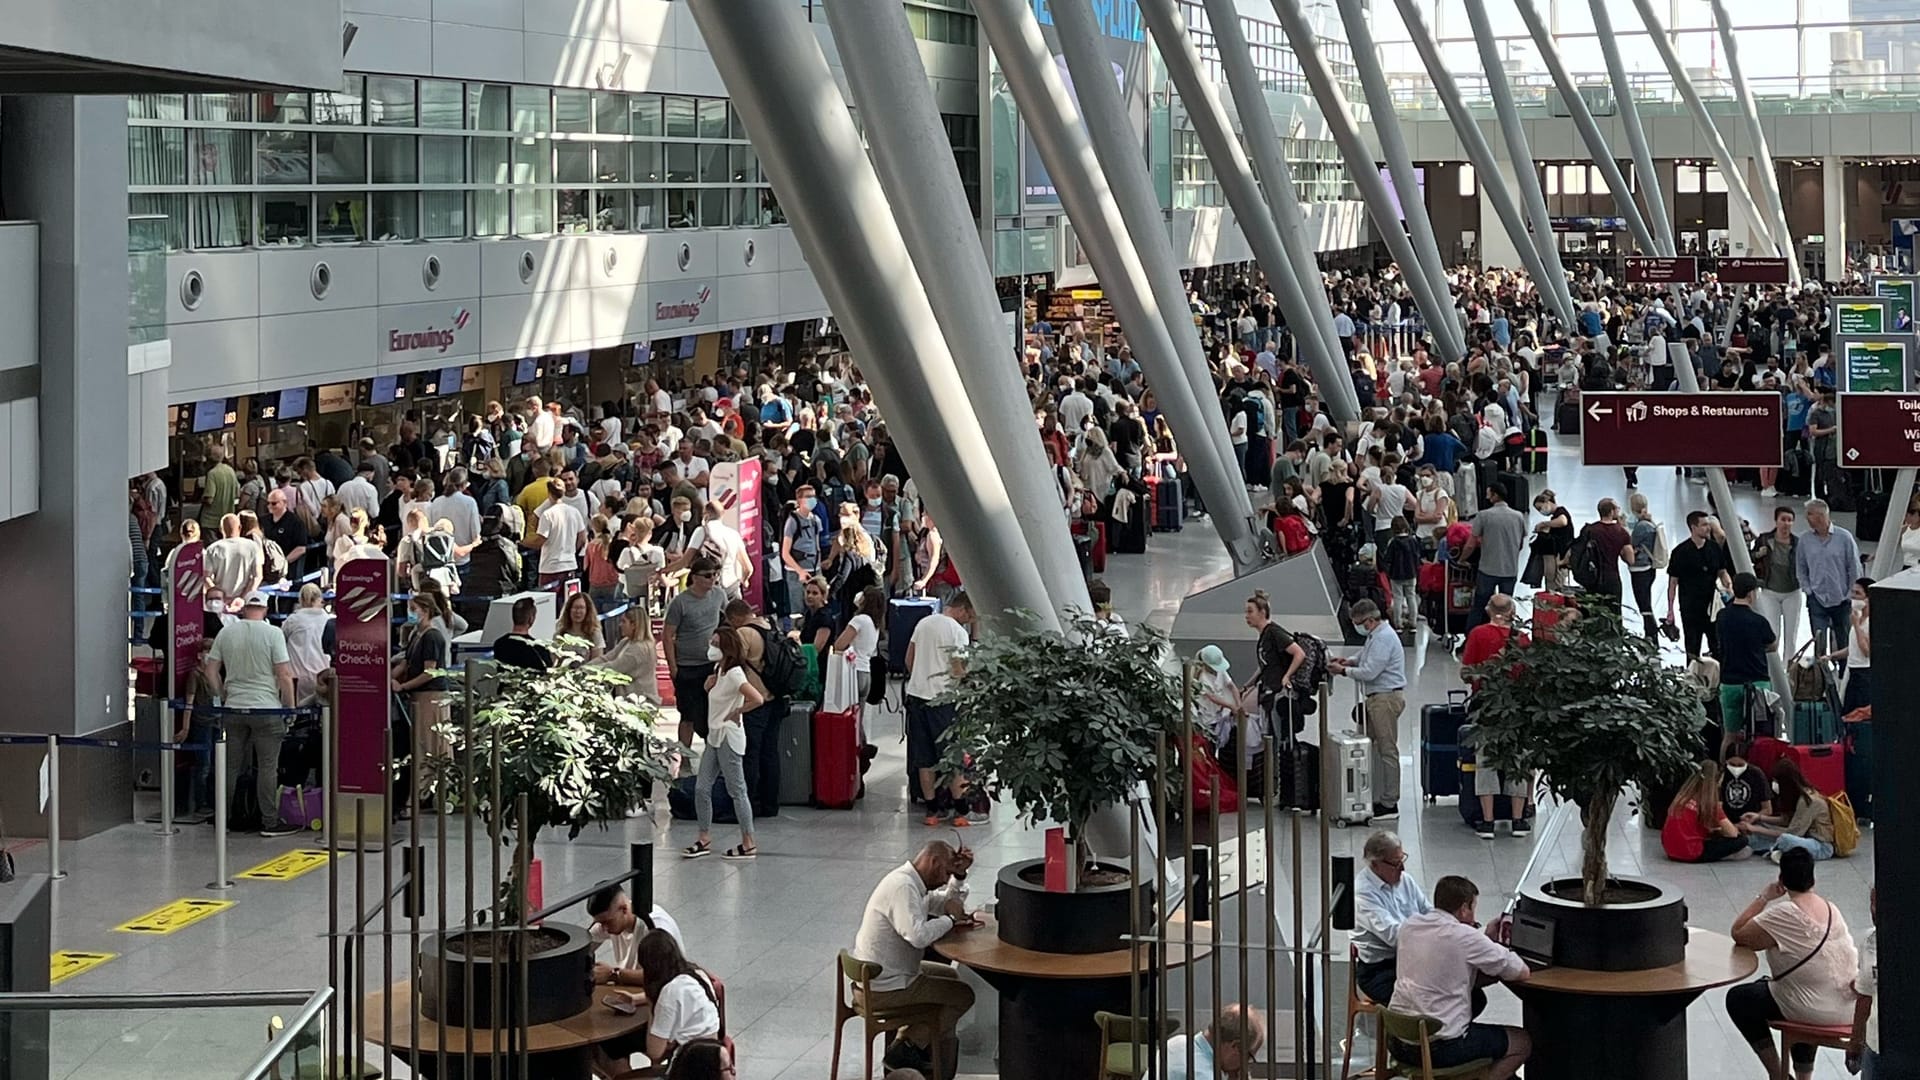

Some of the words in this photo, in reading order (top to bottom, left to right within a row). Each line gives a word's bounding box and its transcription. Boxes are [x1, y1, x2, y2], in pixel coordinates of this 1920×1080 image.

[656, 300, 699, 323] Eurowings
[389, 326, 455, 353] Eurowings
[1653, 405, 1688, 419] Shops
[1690, 406, 1700, 416] &
[1702, 406, 1769, 416] Restaurants
[339, 640, 379, 653] Priority-
[339, 653, 384, 665] Check-in
